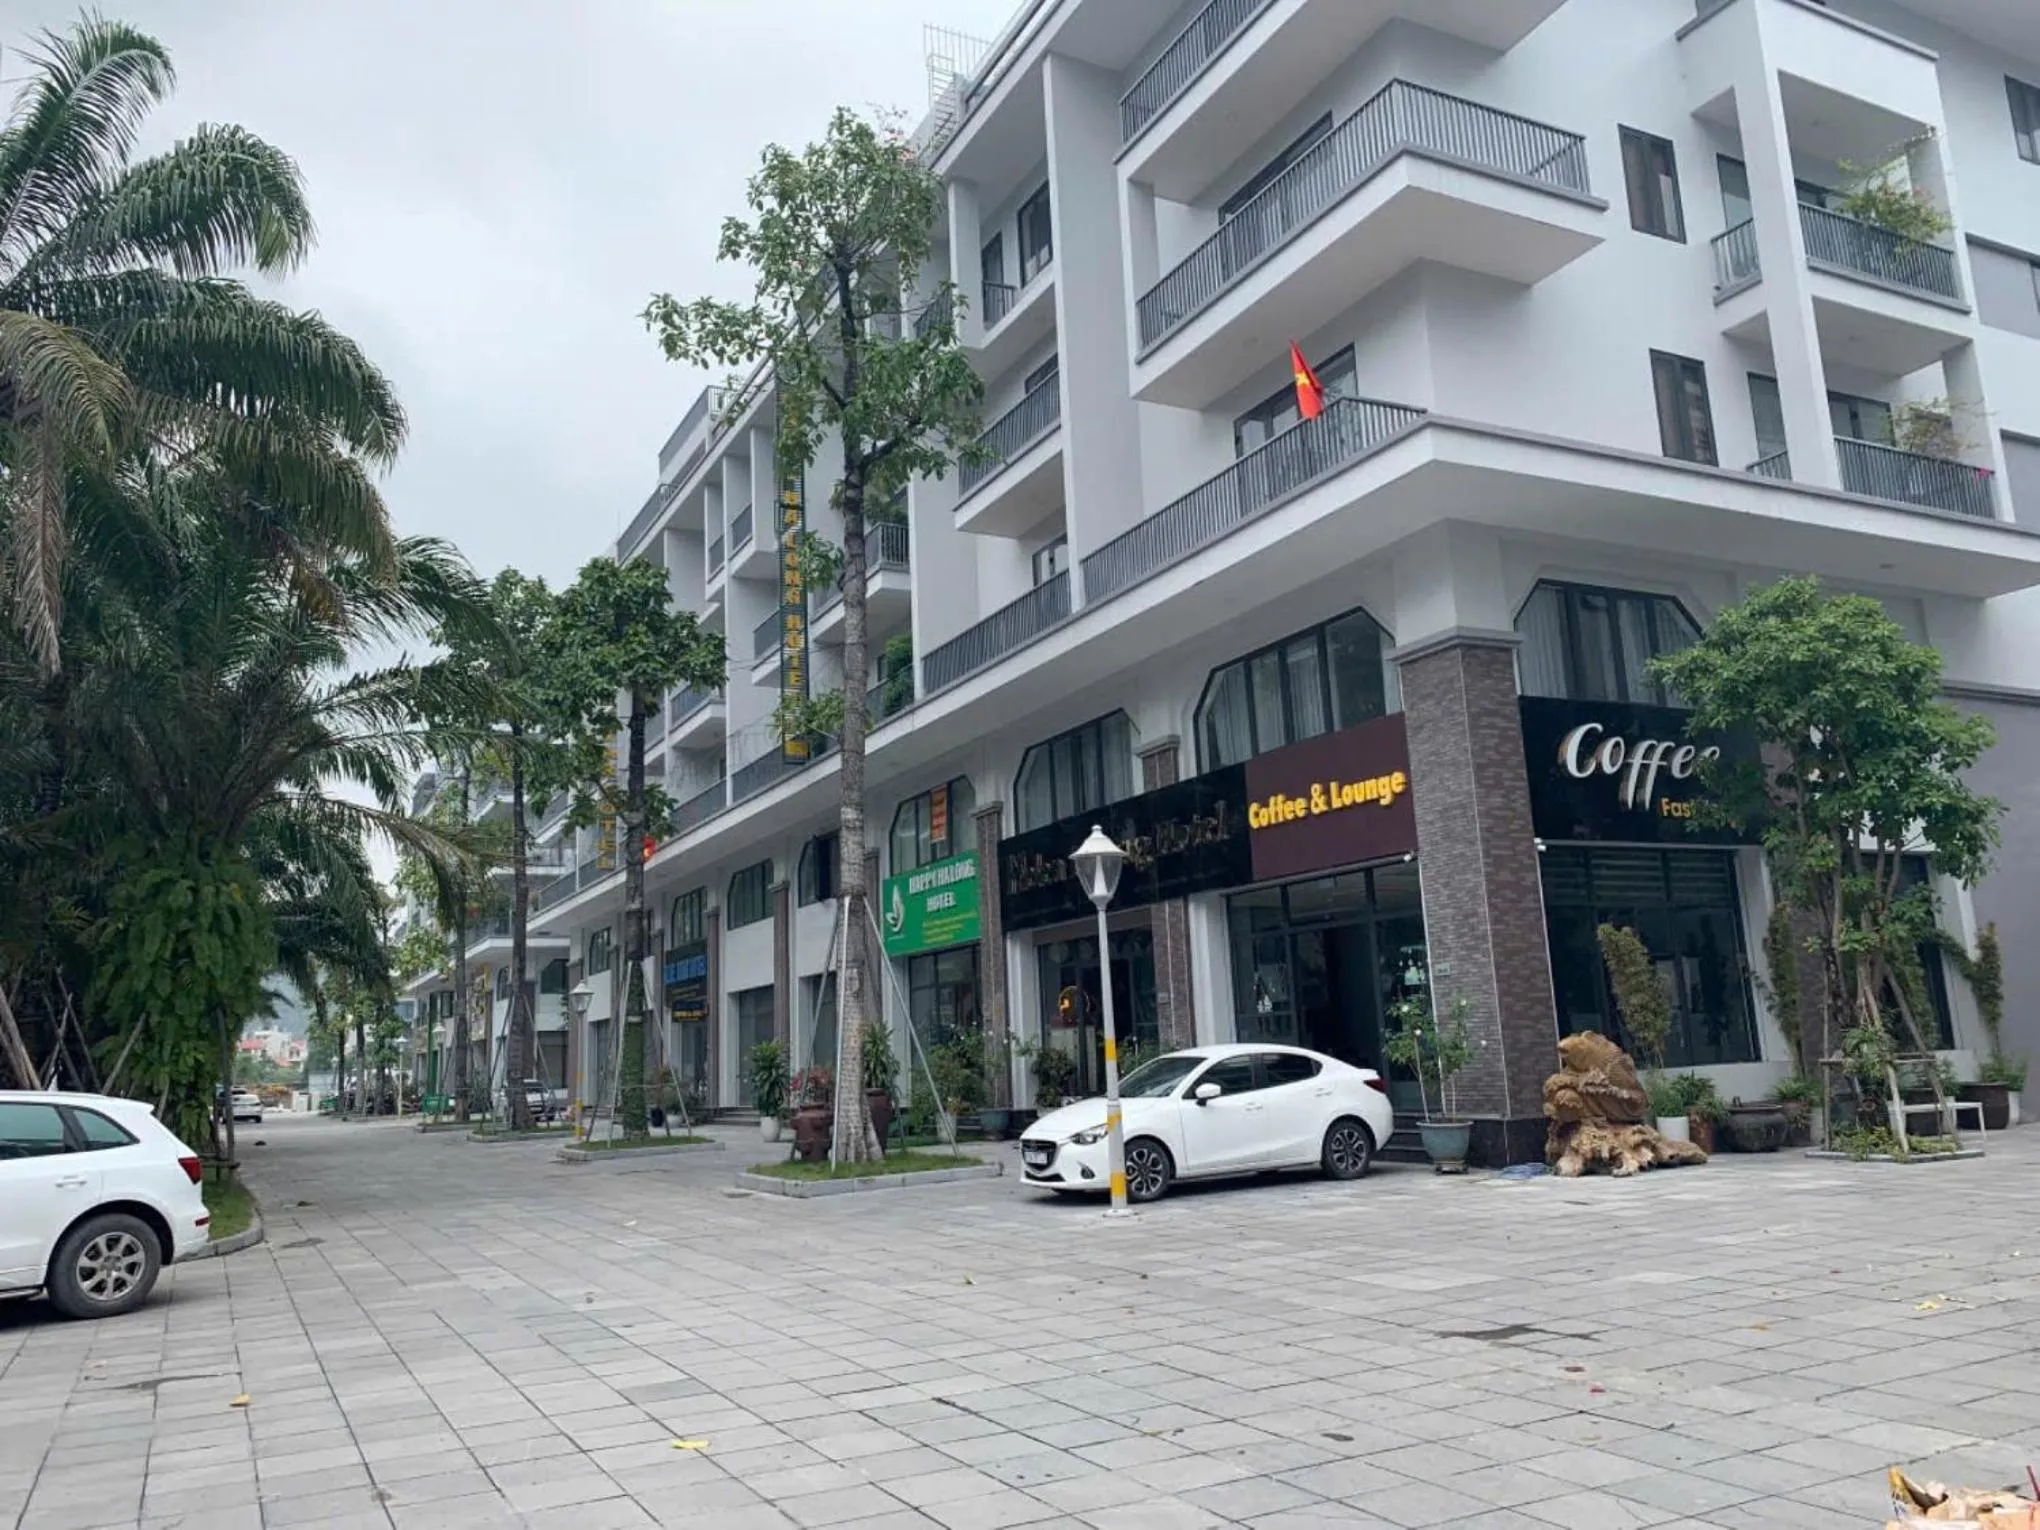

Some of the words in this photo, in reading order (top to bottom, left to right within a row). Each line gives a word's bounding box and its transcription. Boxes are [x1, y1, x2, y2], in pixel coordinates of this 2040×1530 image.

[1248, 794, 1308, 830] Coffee
[1310, 783, 1329, 814] &
[1330, 771, 1407, 806] Lounge
[1660, 797, 1698, 818] Fas
[909, 869, 937, 895] HAPPY
[926, 891, 957, 913] HOTEL
